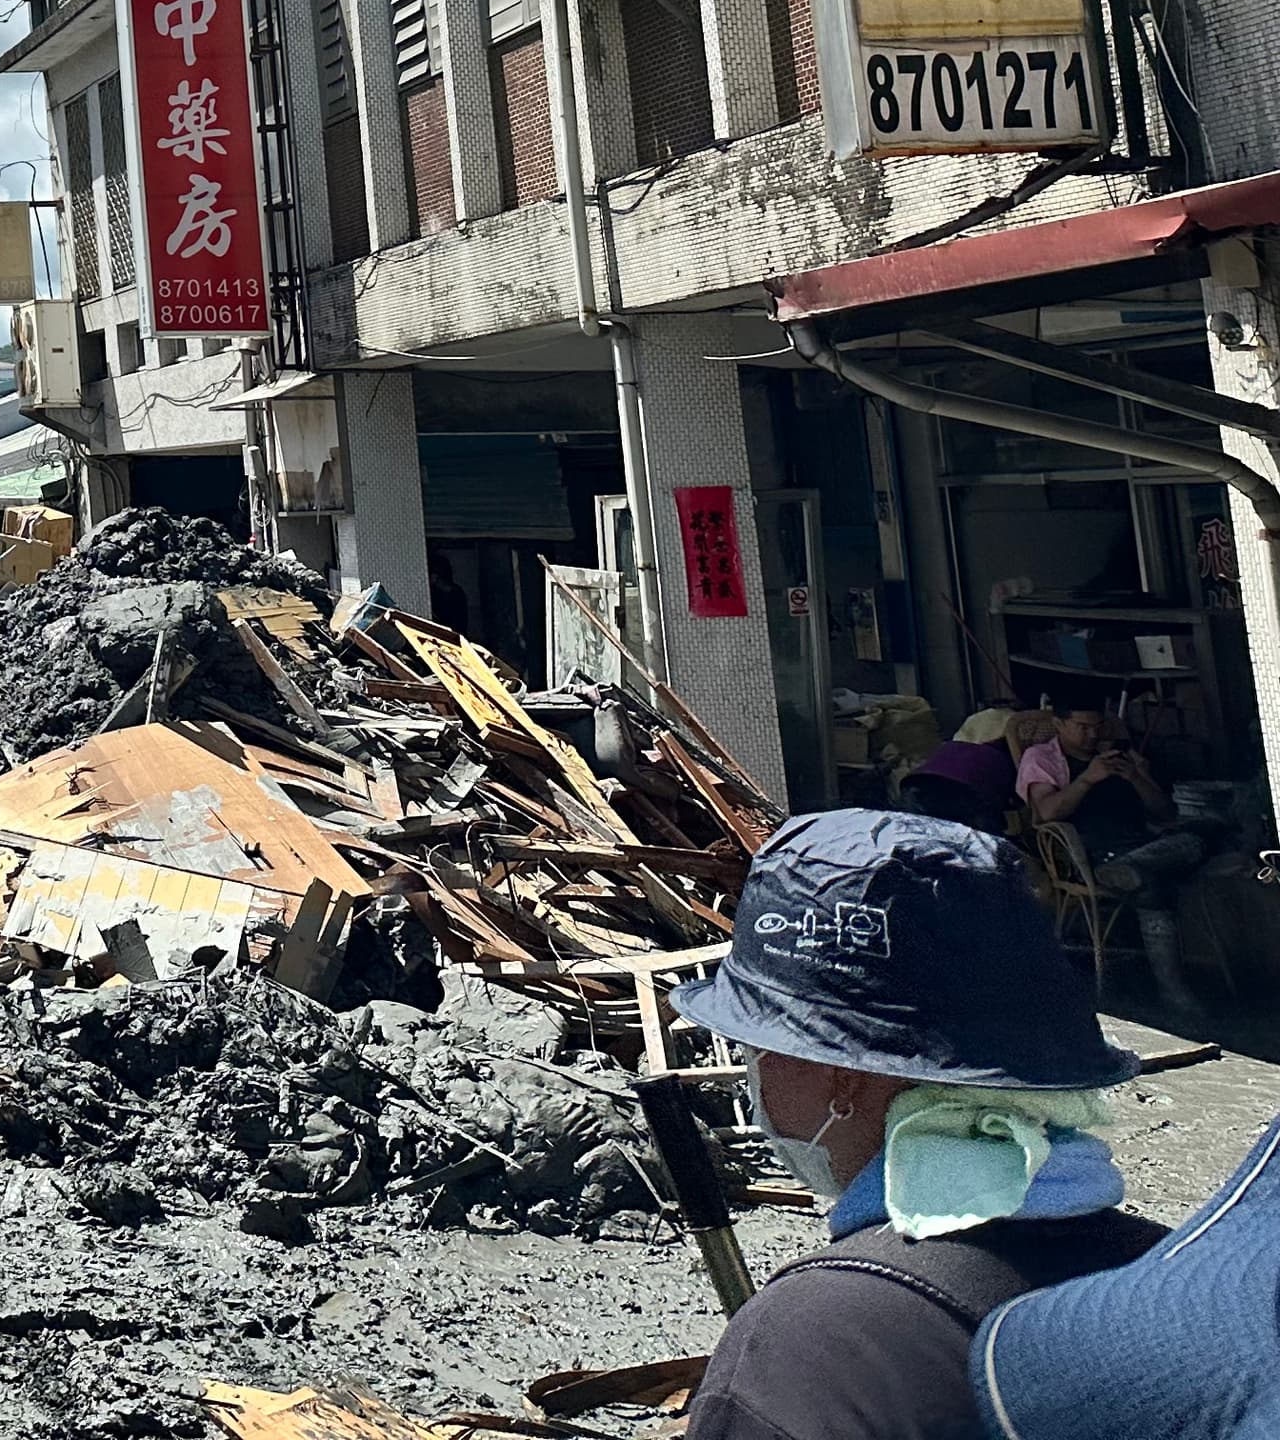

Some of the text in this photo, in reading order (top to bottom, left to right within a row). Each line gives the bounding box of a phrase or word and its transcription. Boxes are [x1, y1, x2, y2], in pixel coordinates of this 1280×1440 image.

[868, 48, 1093, 140] 8701271
[158, 277, 260, 299] 8701413
[160, 303, 261, 326] 8700617
